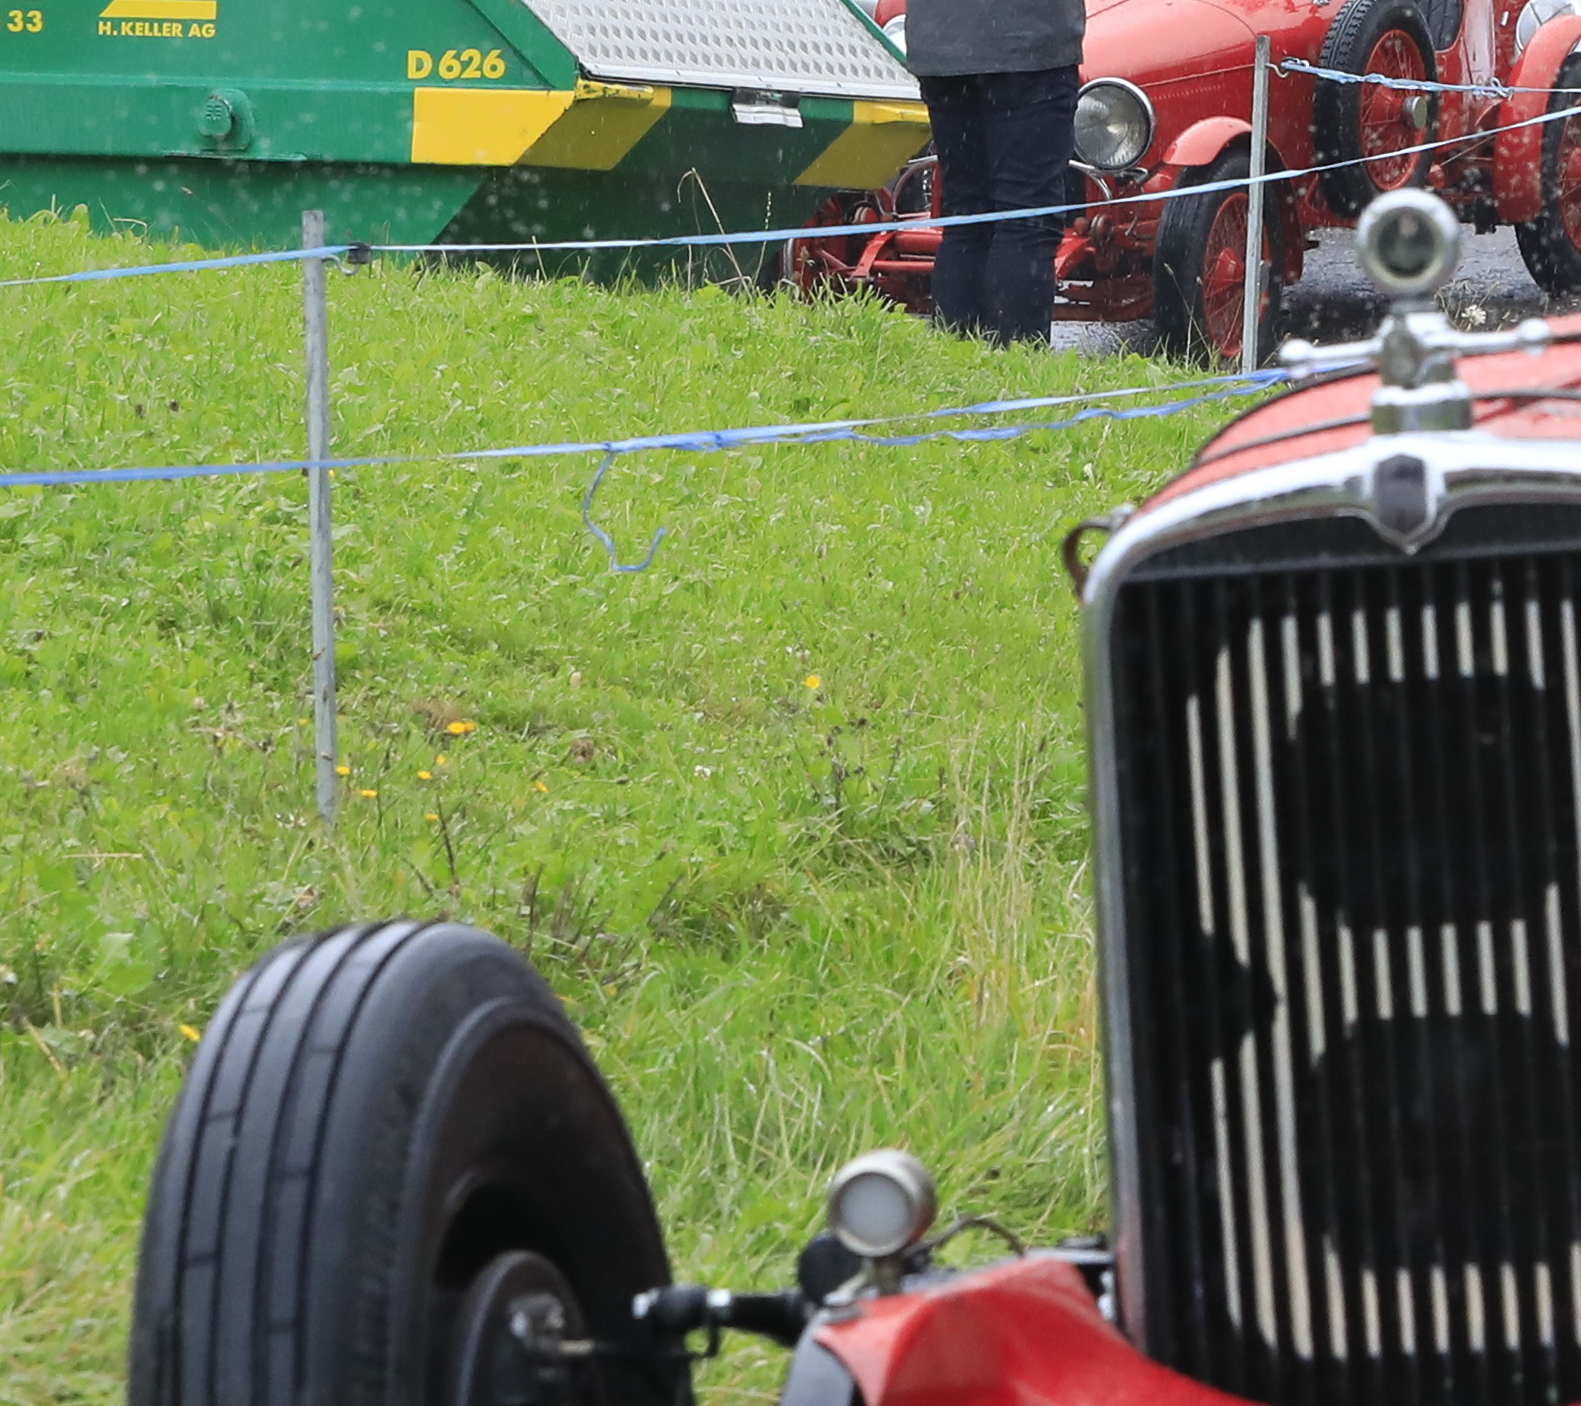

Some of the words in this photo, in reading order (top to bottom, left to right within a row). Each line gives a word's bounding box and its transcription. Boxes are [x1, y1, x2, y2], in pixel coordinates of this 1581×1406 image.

[7, 10, 44, 32] 33
[98, 21, 118, 36] H.
[121, 22, 182, 37] KELLER
[188, 23, 216, 38] AG
[407, 50, 433, 79] D
[438, 49, 506, 79] 626
